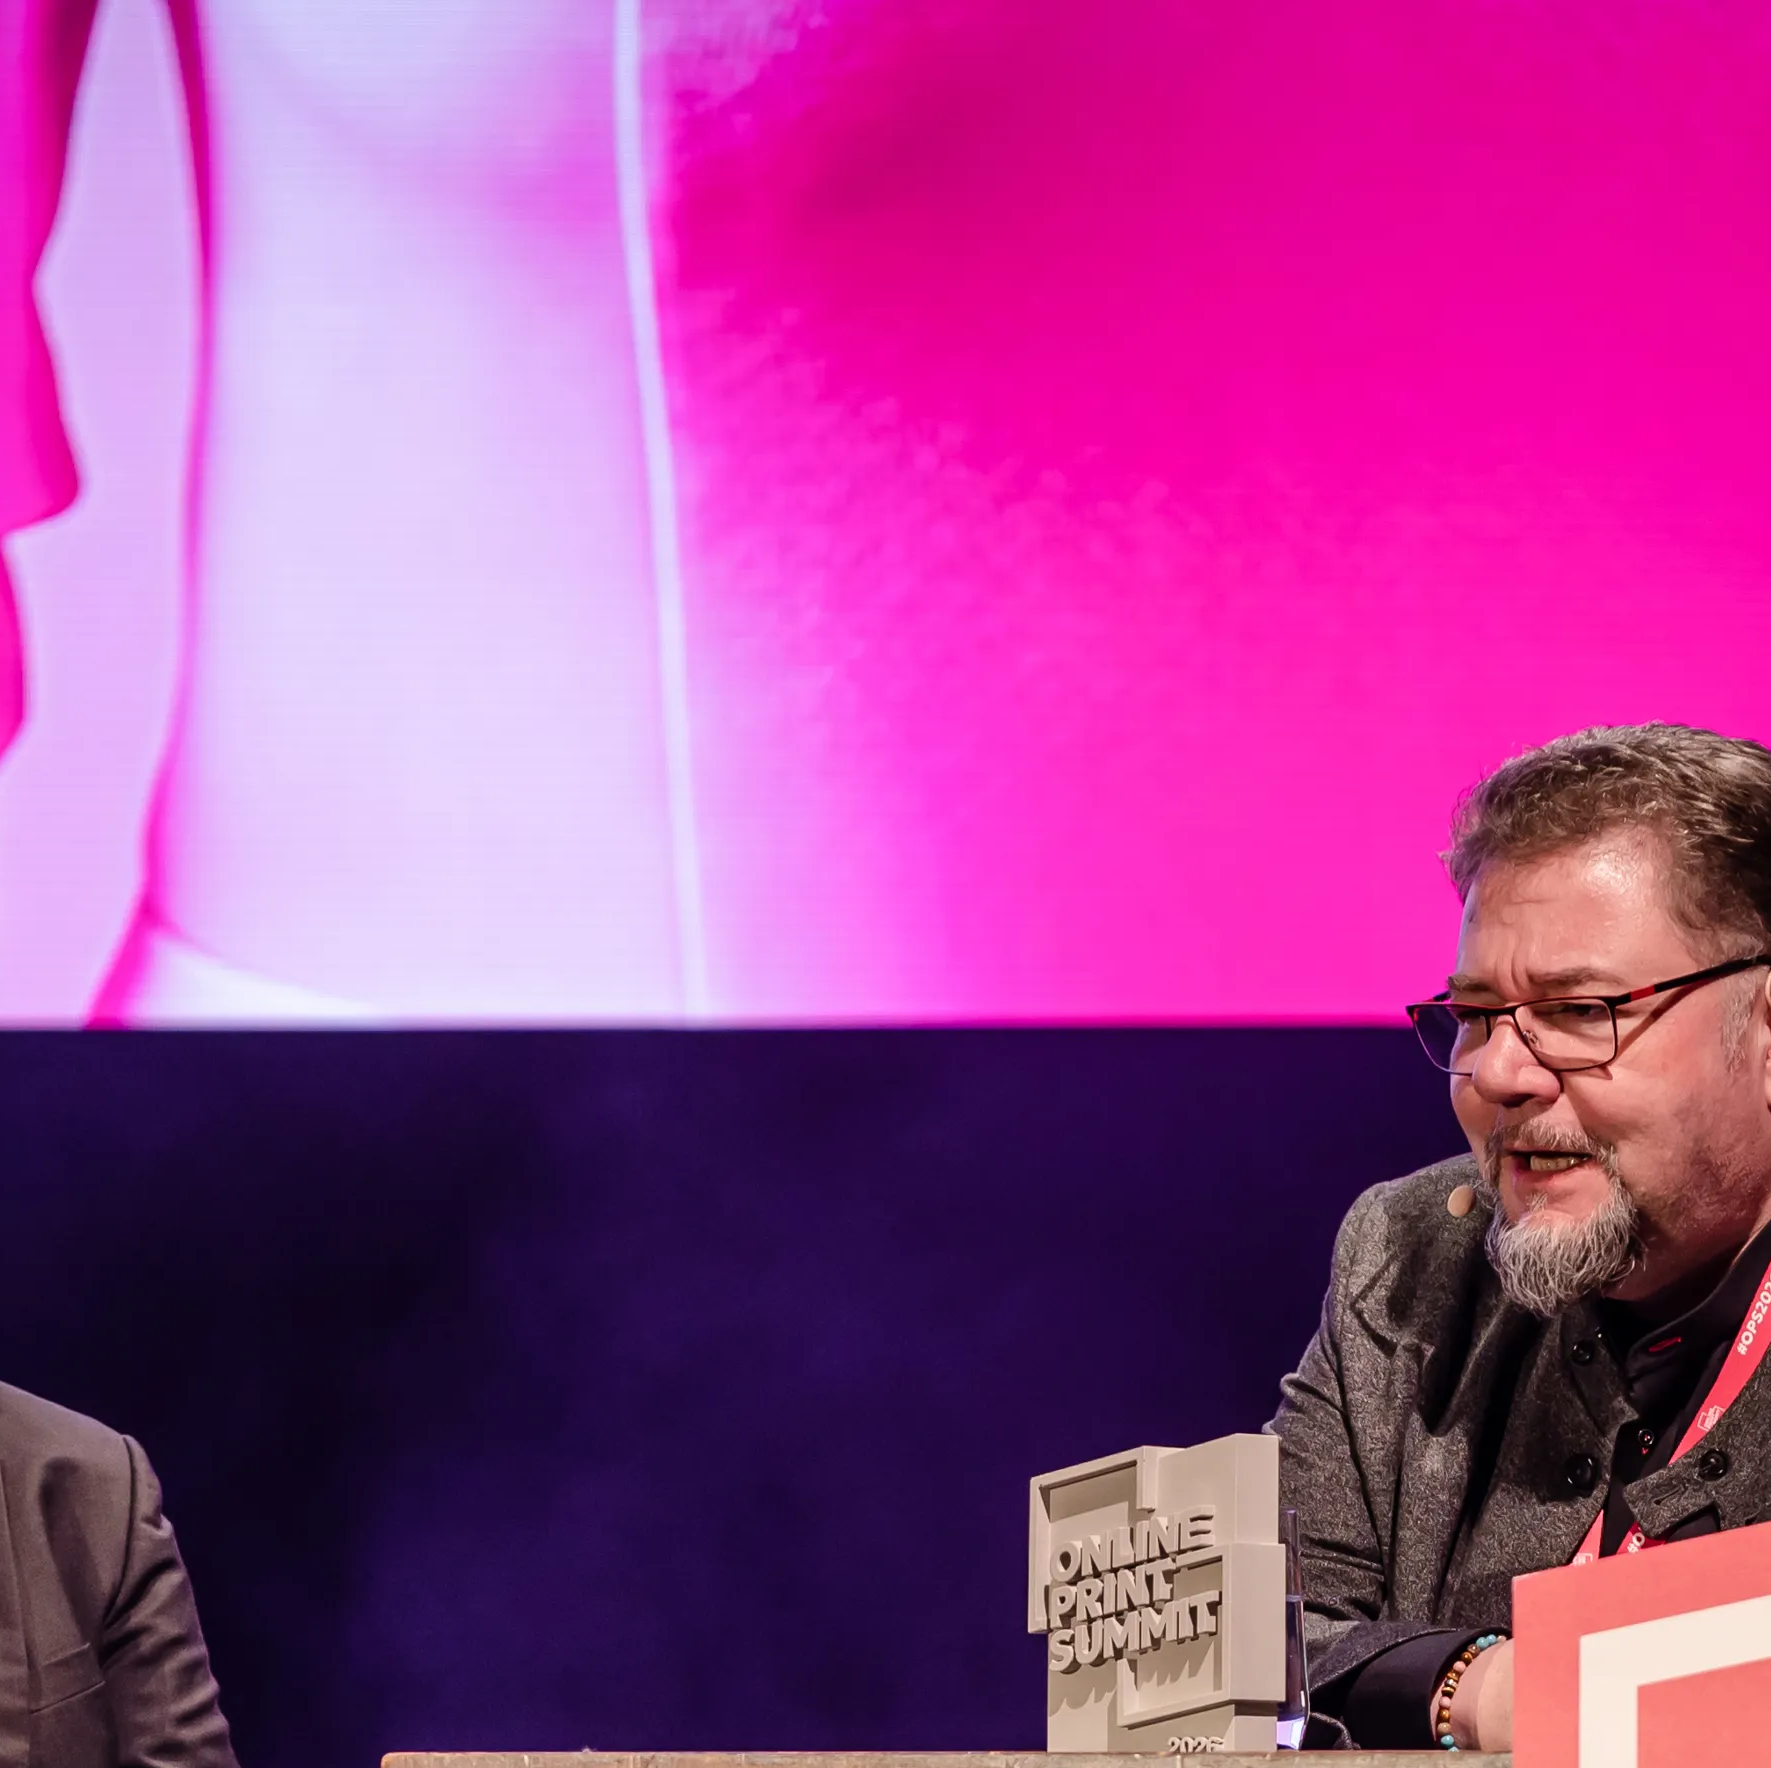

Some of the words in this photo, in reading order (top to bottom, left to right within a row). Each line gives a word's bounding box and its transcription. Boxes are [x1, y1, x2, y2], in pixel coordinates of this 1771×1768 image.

[1049, 1504, 1216, 1584] ONLINE
[1048, 1590, 1221, 1674] SUMMIT
[1049, 1557, 1177, 1630] PRINT
